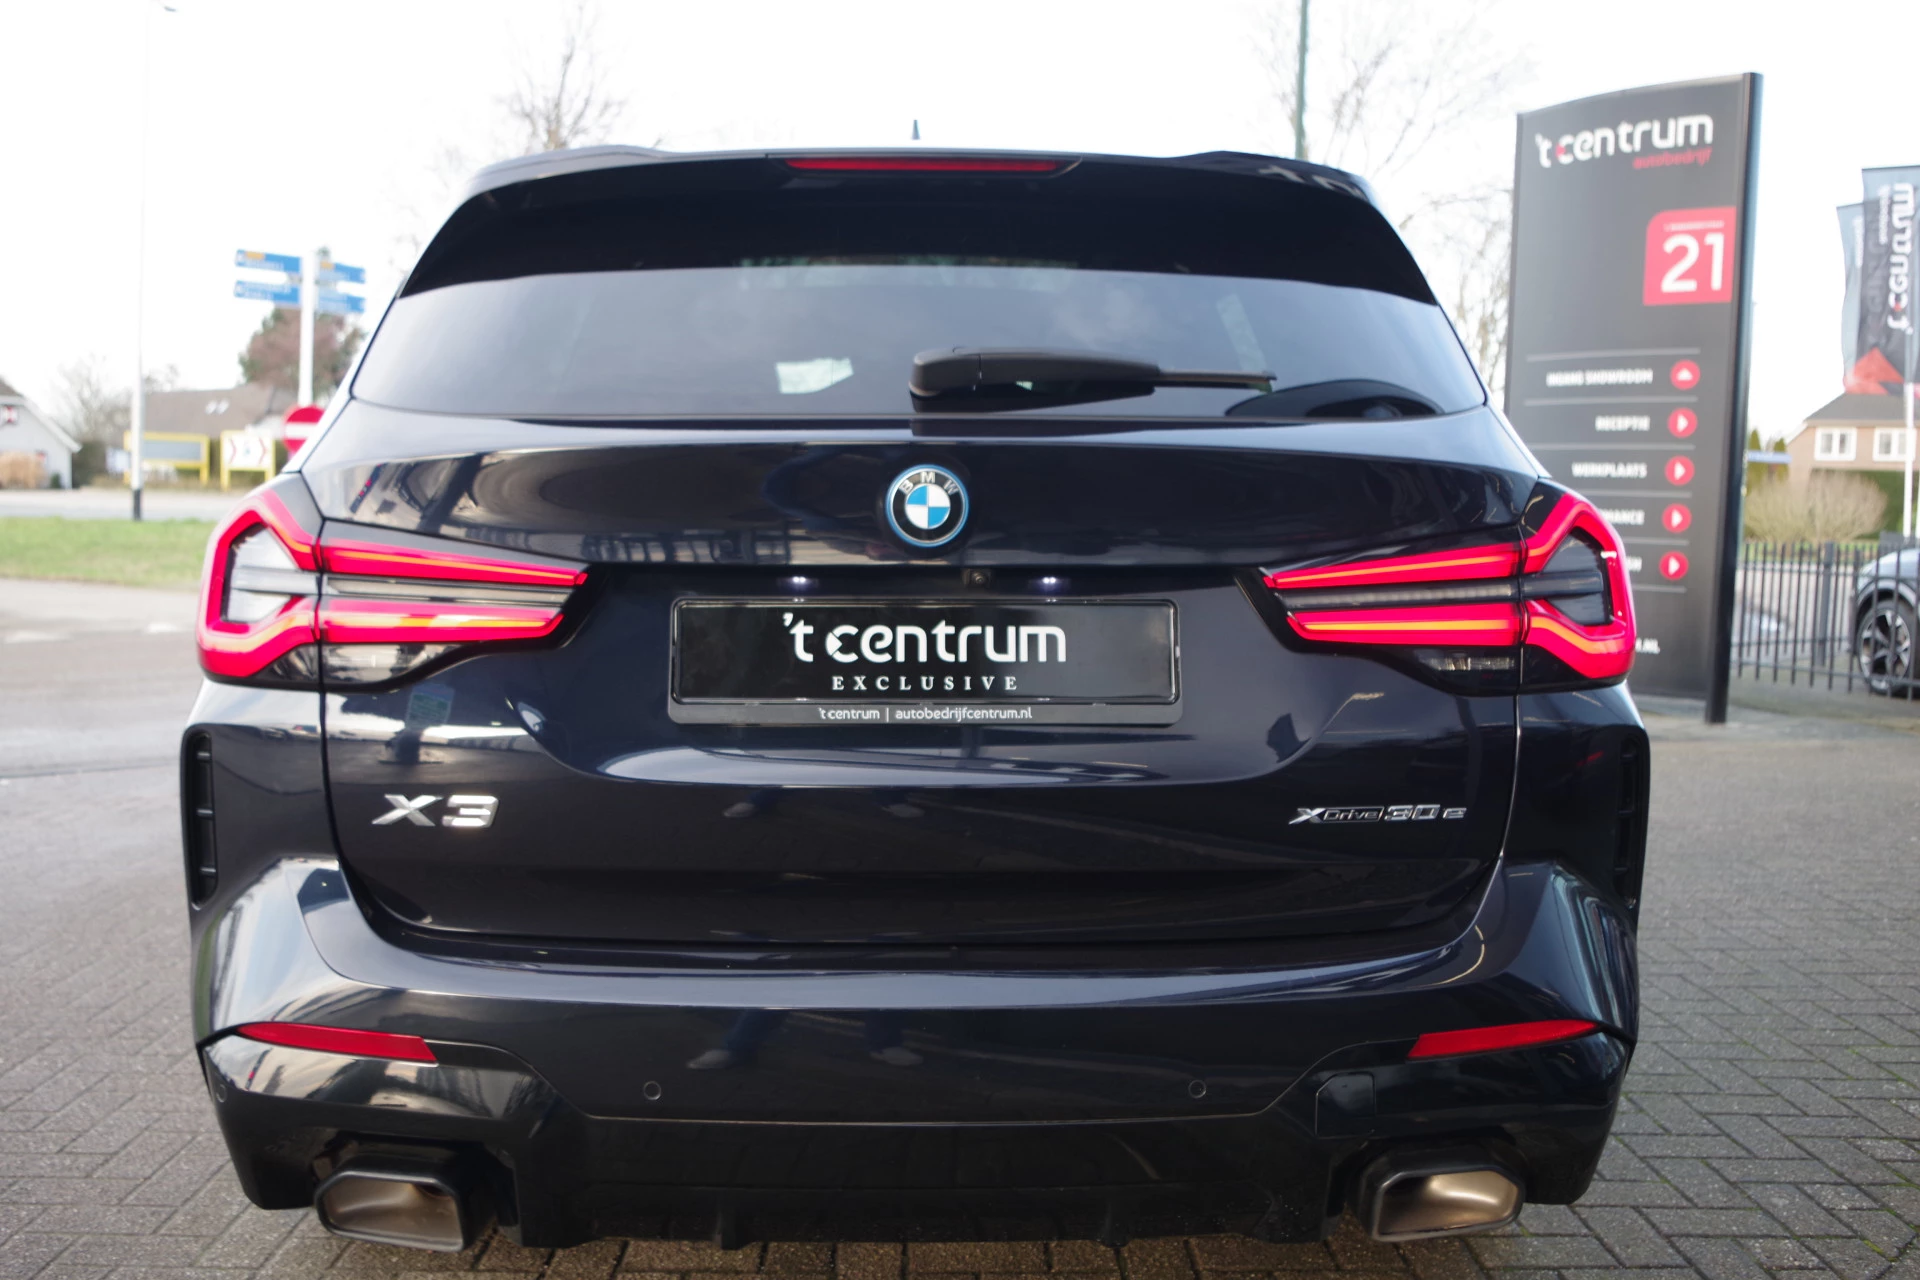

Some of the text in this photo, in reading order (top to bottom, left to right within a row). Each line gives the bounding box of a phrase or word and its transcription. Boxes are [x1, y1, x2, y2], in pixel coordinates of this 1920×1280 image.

[1556, 114, 1714, 165] centrum
[1661, 232, 1725, 293] 21
[898, 470, 960, 496] BMW
[782, 612, 1067, 662] 't centrum
[832, 675, 1017, 691] EXCLUSIVE
[827, 708, 880, 719] centrum
[895, 707, 1032, 722] autobedrijfcentrum.nl
[371, 793, 499, 828] X3
